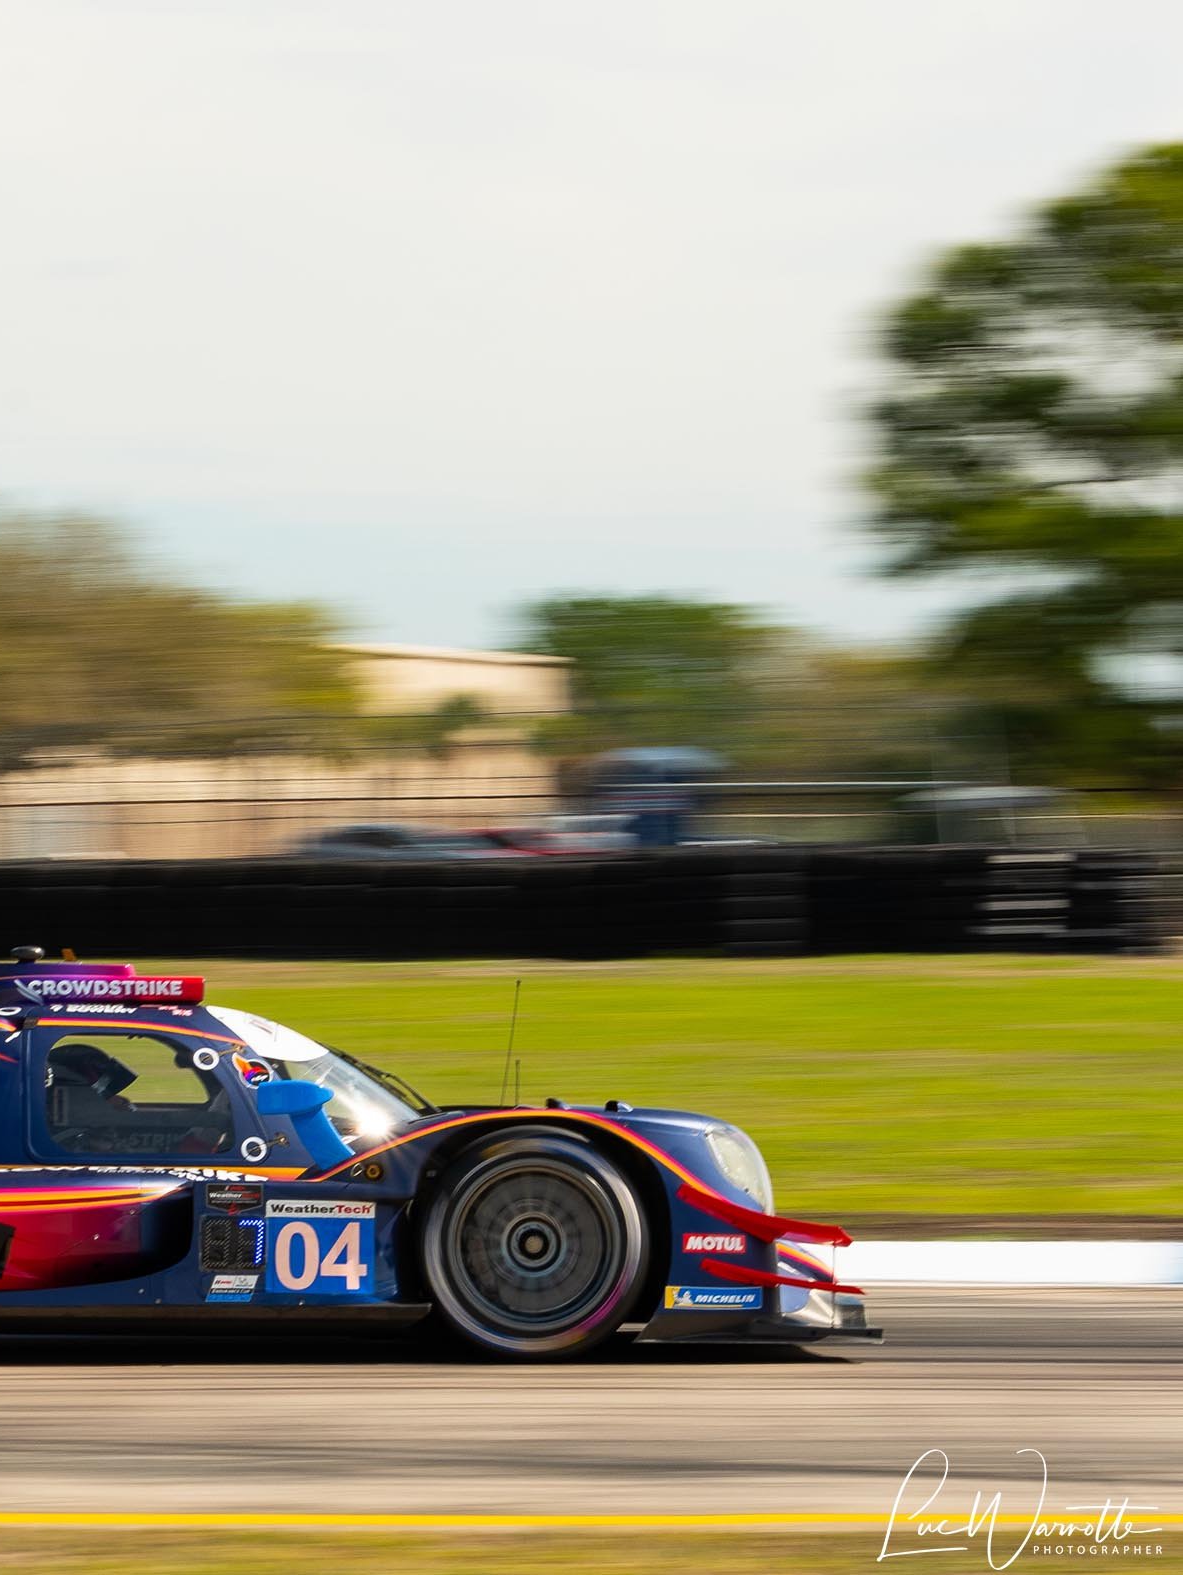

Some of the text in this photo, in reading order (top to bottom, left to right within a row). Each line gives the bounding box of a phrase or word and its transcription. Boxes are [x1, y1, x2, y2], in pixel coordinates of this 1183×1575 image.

[27, 979, 183, 996] CROWDSTRIKE
[271, 1203, 374, 1215] WeatherTech
[686, 1236, 744, 1251] MOTUL
[275, 1221, 367, 1291] 04
[694, 1294, 756, 1303] MICHELIN
